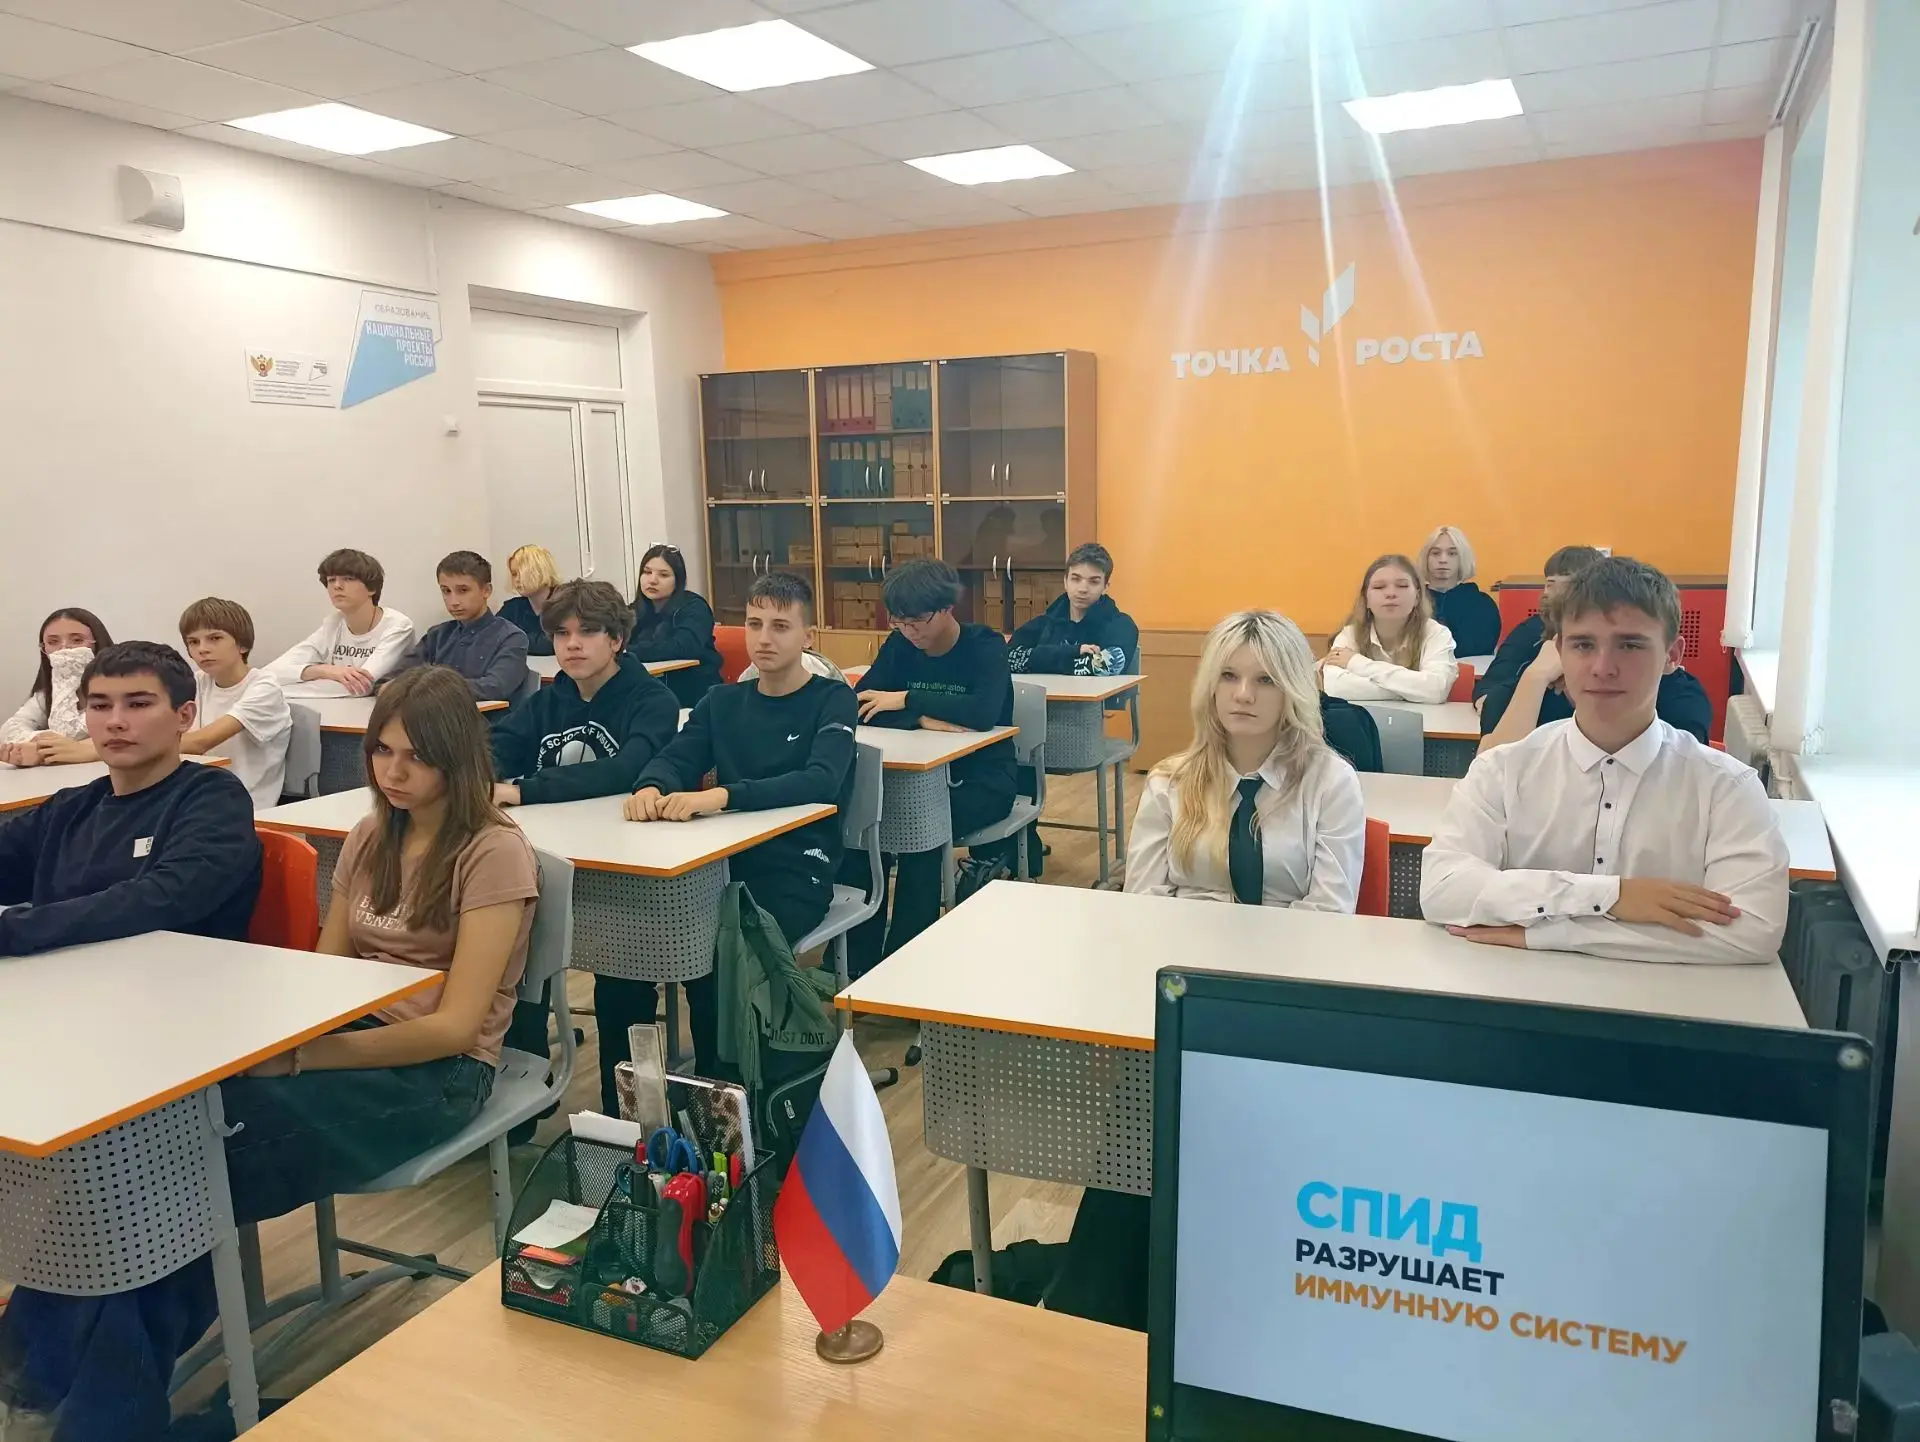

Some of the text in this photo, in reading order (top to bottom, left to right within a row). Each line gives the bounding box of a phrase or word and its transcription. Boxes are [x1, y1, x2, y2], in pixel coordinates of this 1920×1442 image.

[366, 321, 432, 342] НАЦИОНАЛЬНЫЕ
[396, 338, 433, 355] ПРОЕКТЫ
[404, 352, 434, 367] РОССИИ
[1171, 331, 1484, 379] ТОЧКА РОСТА
[769, 1028, 796, 1044] JUST
[800, 1032, 815, 1045] DO
[1296, 1181, 1483, 1263] СПИД
[1295, 1238, 1504, 1296] РАЗРУШАЕТ
[1295, 1273, 1688, 1365] ИММУННУЮ СИСТЕМУ
